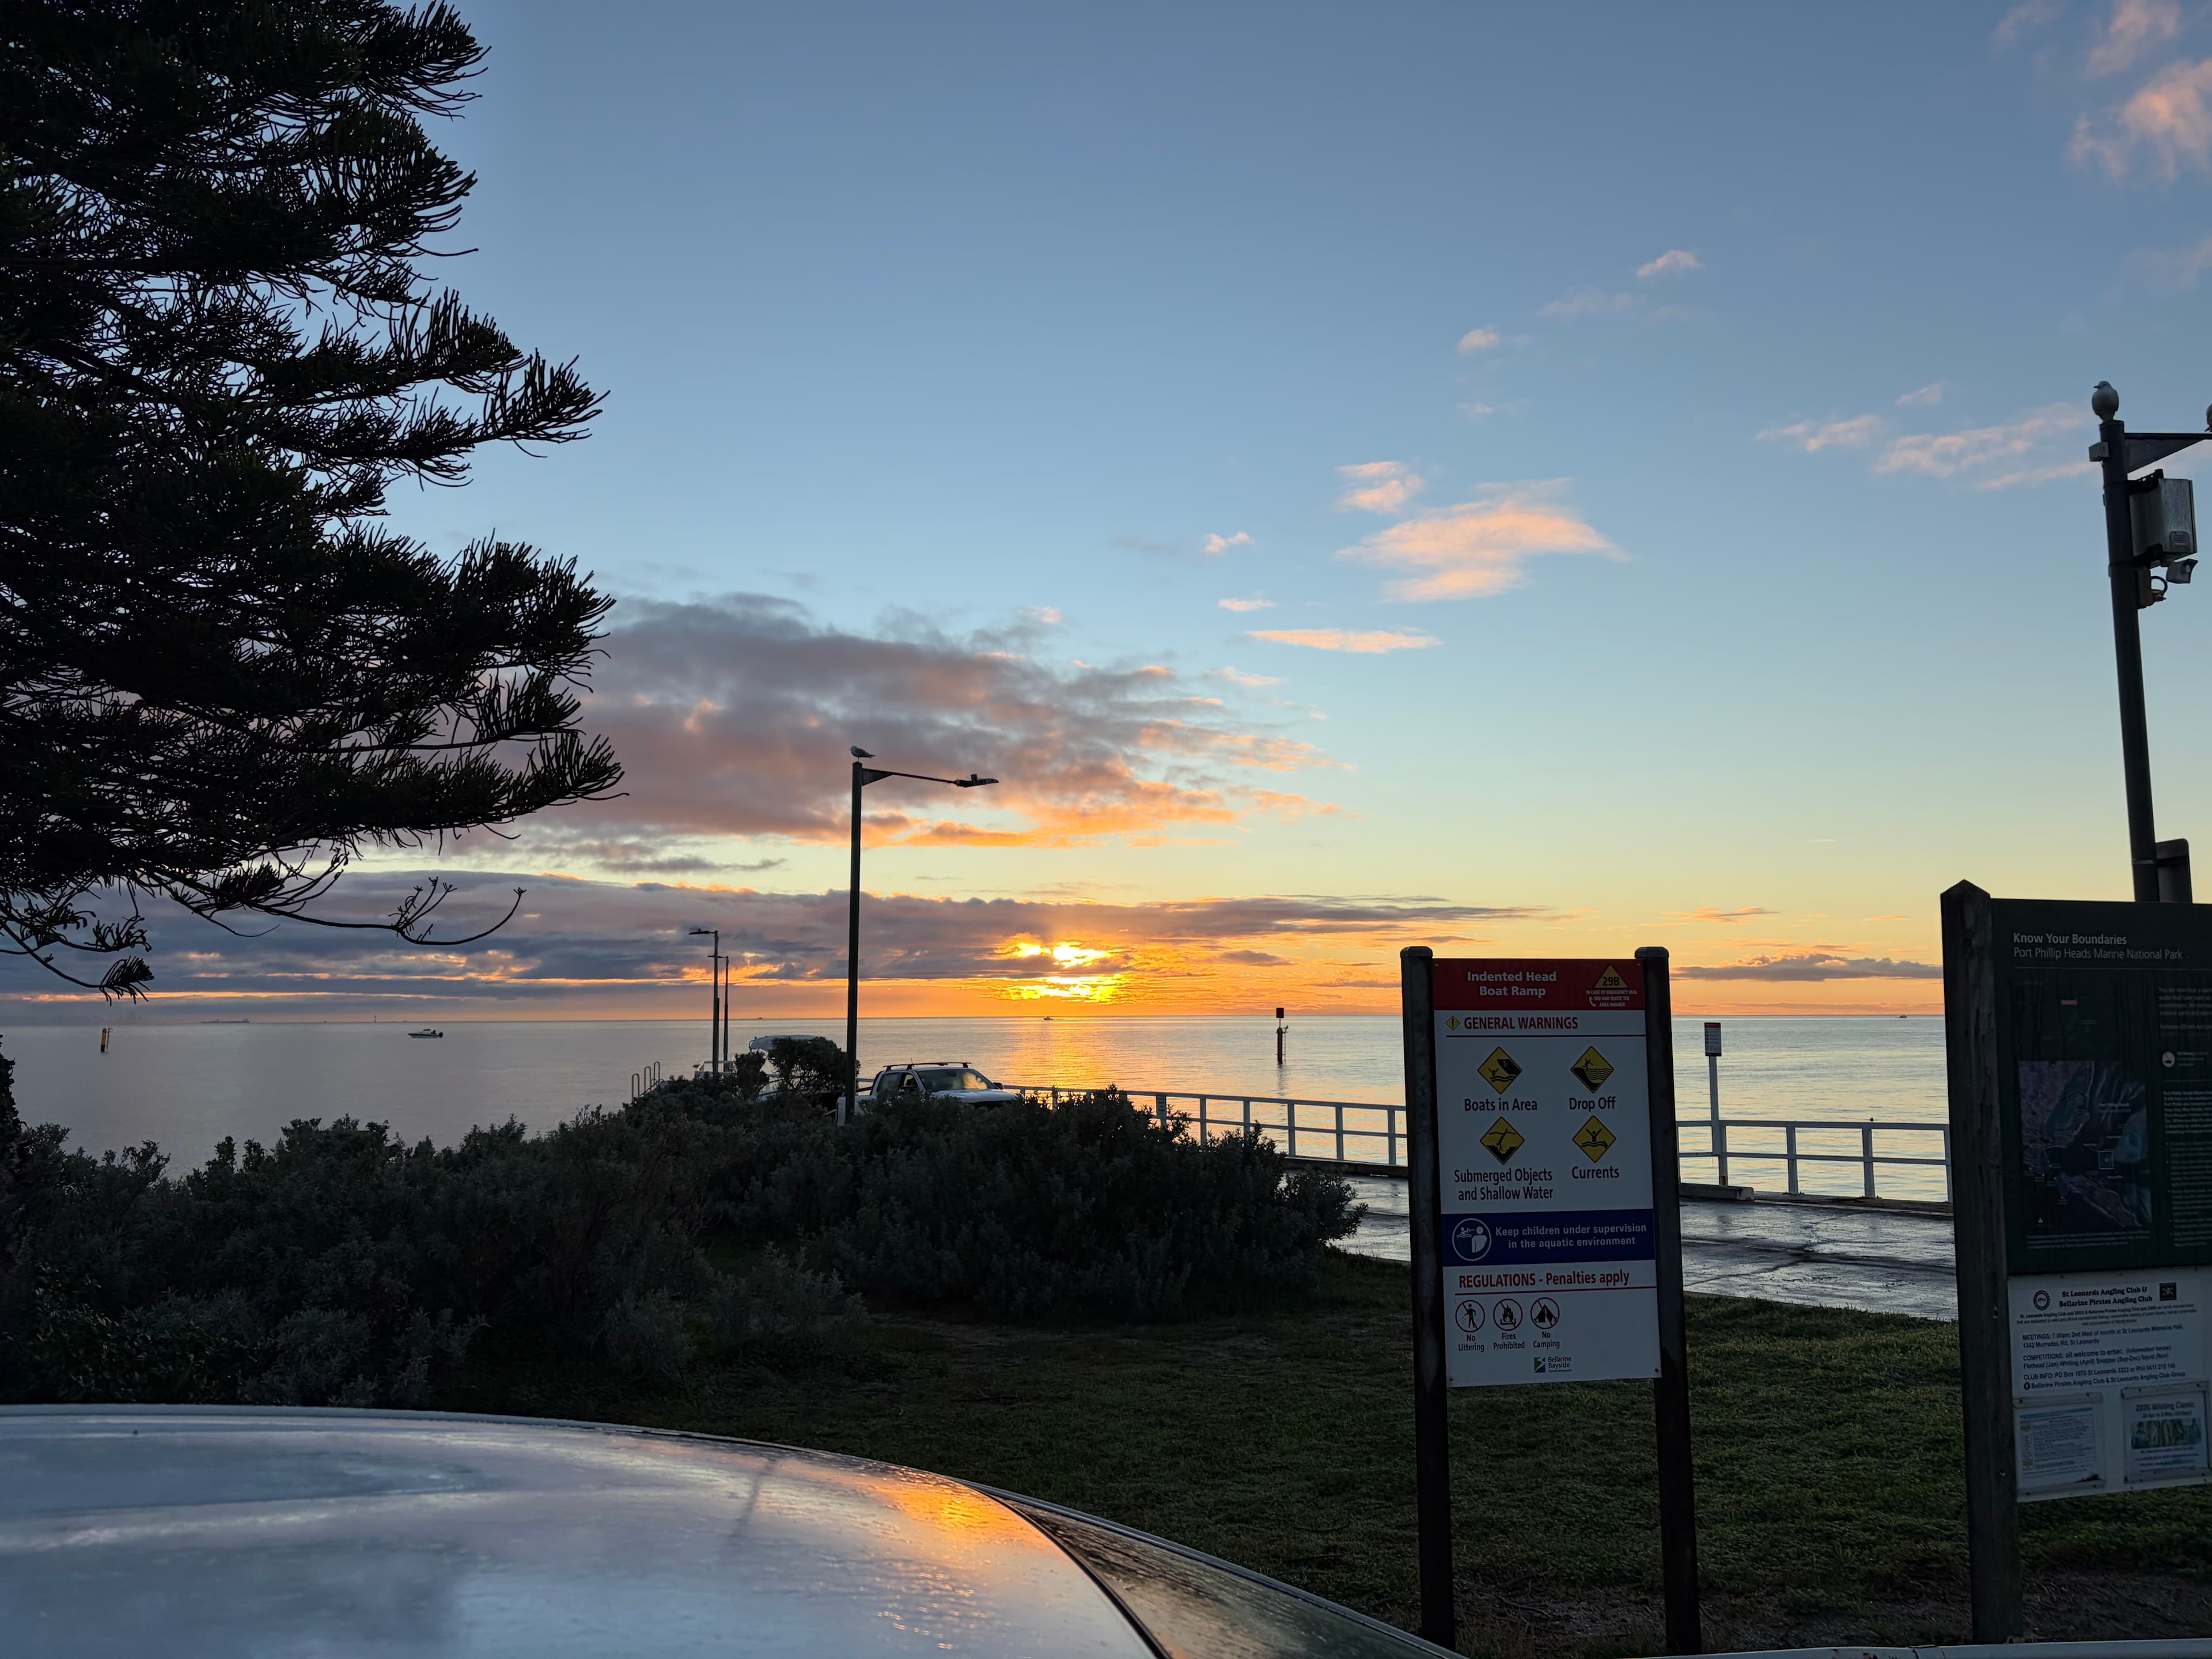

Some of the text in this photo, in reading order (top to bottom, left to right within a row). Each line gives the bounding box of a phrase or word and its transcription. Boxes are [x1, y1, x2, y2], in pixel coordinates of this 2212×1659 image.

[2014, 933, 2127, 945] Know Your Boundaries
[2014, 947, 2183, 960] Port Phillip Heads Marine National Park
[1467, 971, 1556, 982] Indented Head
[1603, 977, 1619, 986] 29B
[1479, 986, 1546, 998] Boat Ramp
[1464, 1017, 1578, 1029] GENERAL WARNINGS
[1464, 1098, 1537, 1111] Boats in Area
[1569, 1096, 1616, 1111] Drop Off
[1455, 1168, 1552, 1185] Submerged Objects
[1572, 1166, 1619, 1179] Currents
[1459, 1186, 1553, 1200] and Shallow Water
[1496, 1224, 1646, 1238] Keep children under supervision
[1509, 1237, 1635, 1249] in the aquatic environment
[1459, 1274, 1536, 1288] REGULATIONS
[1546, 1271, 1596, 1285] Penalties
[1600, 1270, 1630, 1286] apply
[2072, 1289, 2099, 1297] Leonards
[2101, 1287, 2124, 1296] Angling
[2059, 1299, 2088, 1307] Bellarine
[2113, 1297, 2137, 1305] Angling
[1459, 1343, 1484, 1352] Littering
[1493, 1341, 1525, 1350] Prohibited
[1533, 1340, 1560, 1349] Camping
[2118, 1355, 2141, 1363] (Sep-Dec)
